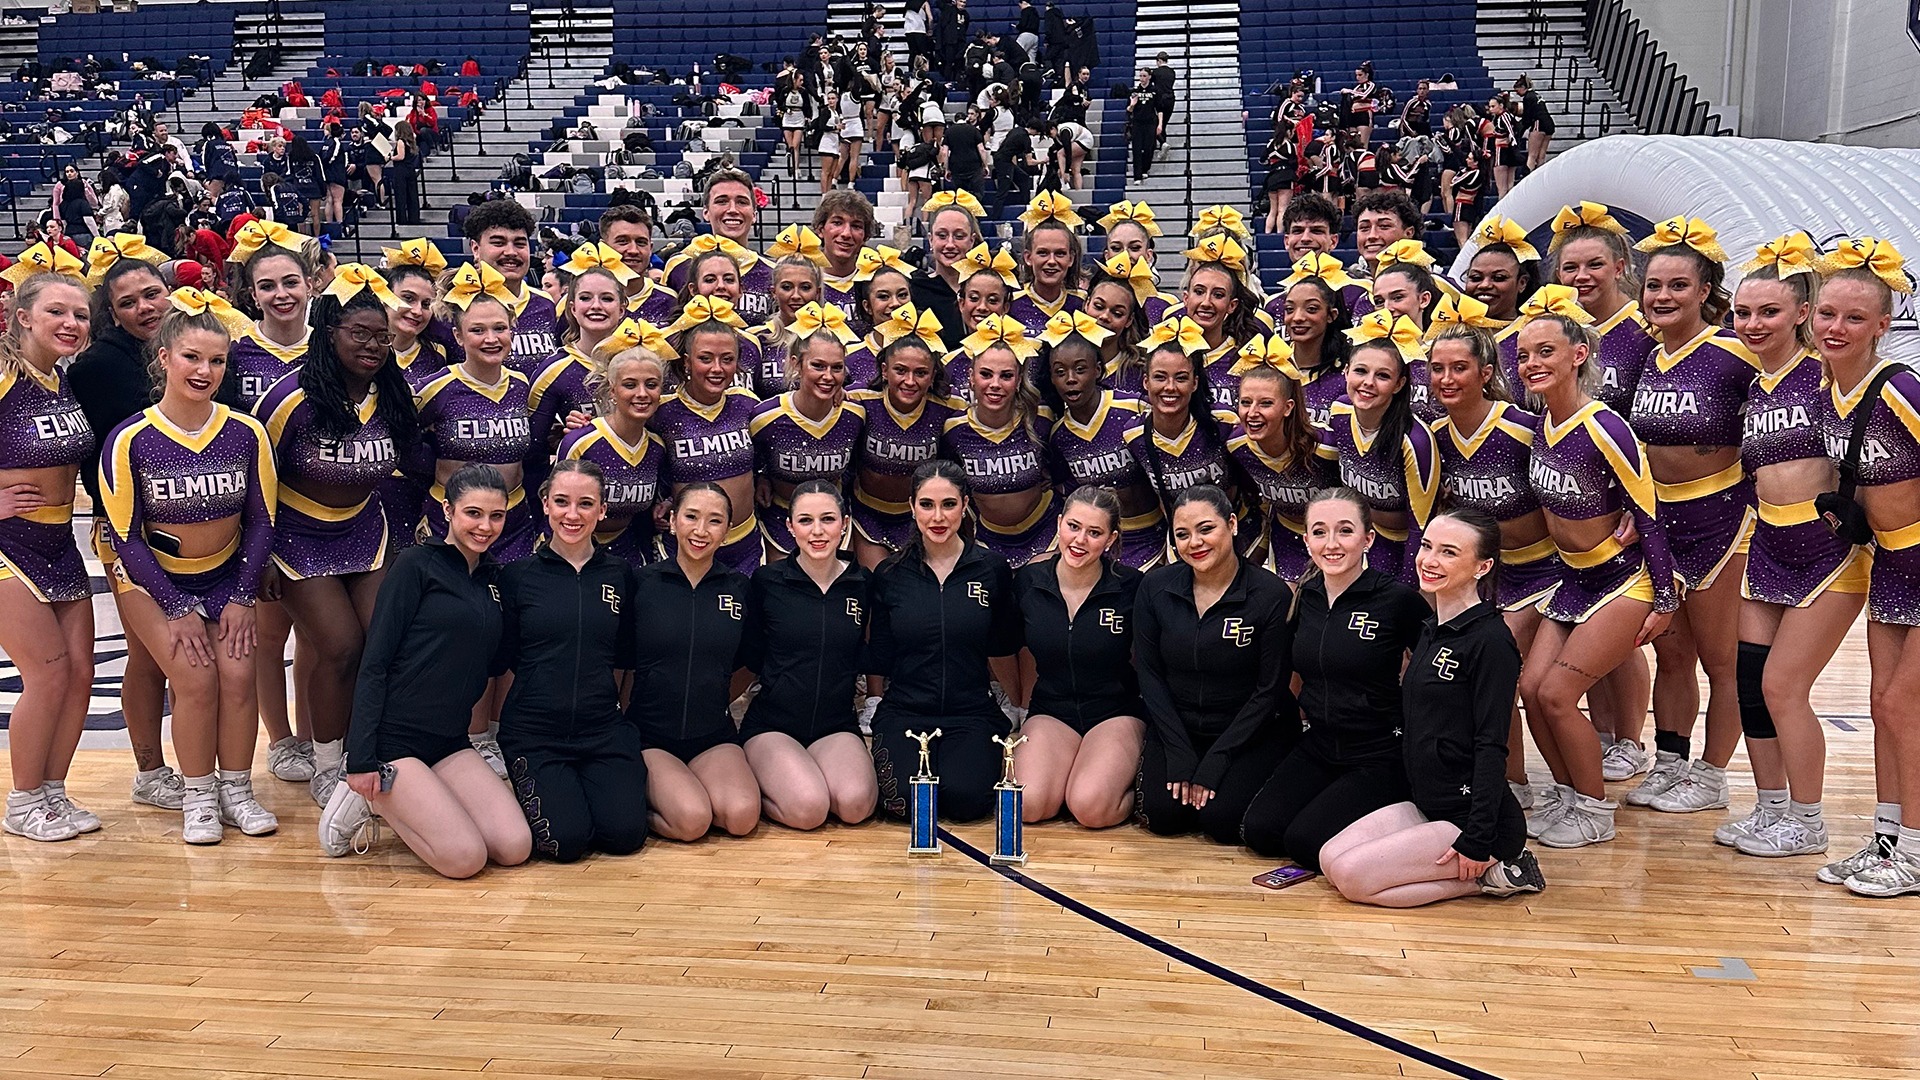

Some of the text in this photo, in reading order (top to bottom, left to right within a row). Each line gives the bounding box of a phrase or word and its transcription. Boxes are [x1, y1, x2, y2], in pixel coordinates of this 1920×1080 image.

[508, 332, 557, 356] MIRA
[318, 438, 398, 464] ELMIR
[674, 428, 753, 458] ELMIRA
[866, 435, 938, 461] ELMIRA
[963, 451, 1038, 477] ELMIRA
[151, 470, 247, 500] ELMIRA
[602, 583, 621, 614] EC
[718, 594, 742, 620] EC
[967, 582, 989, 607] EC
[846, 597, 863, 626] EC
[1099, 608, 1124, 634] EC
[1222, 617, 1254, 647] EC
[1348, 611, 1379, 640] EC
[1431, 647, 1460, 681] EC
